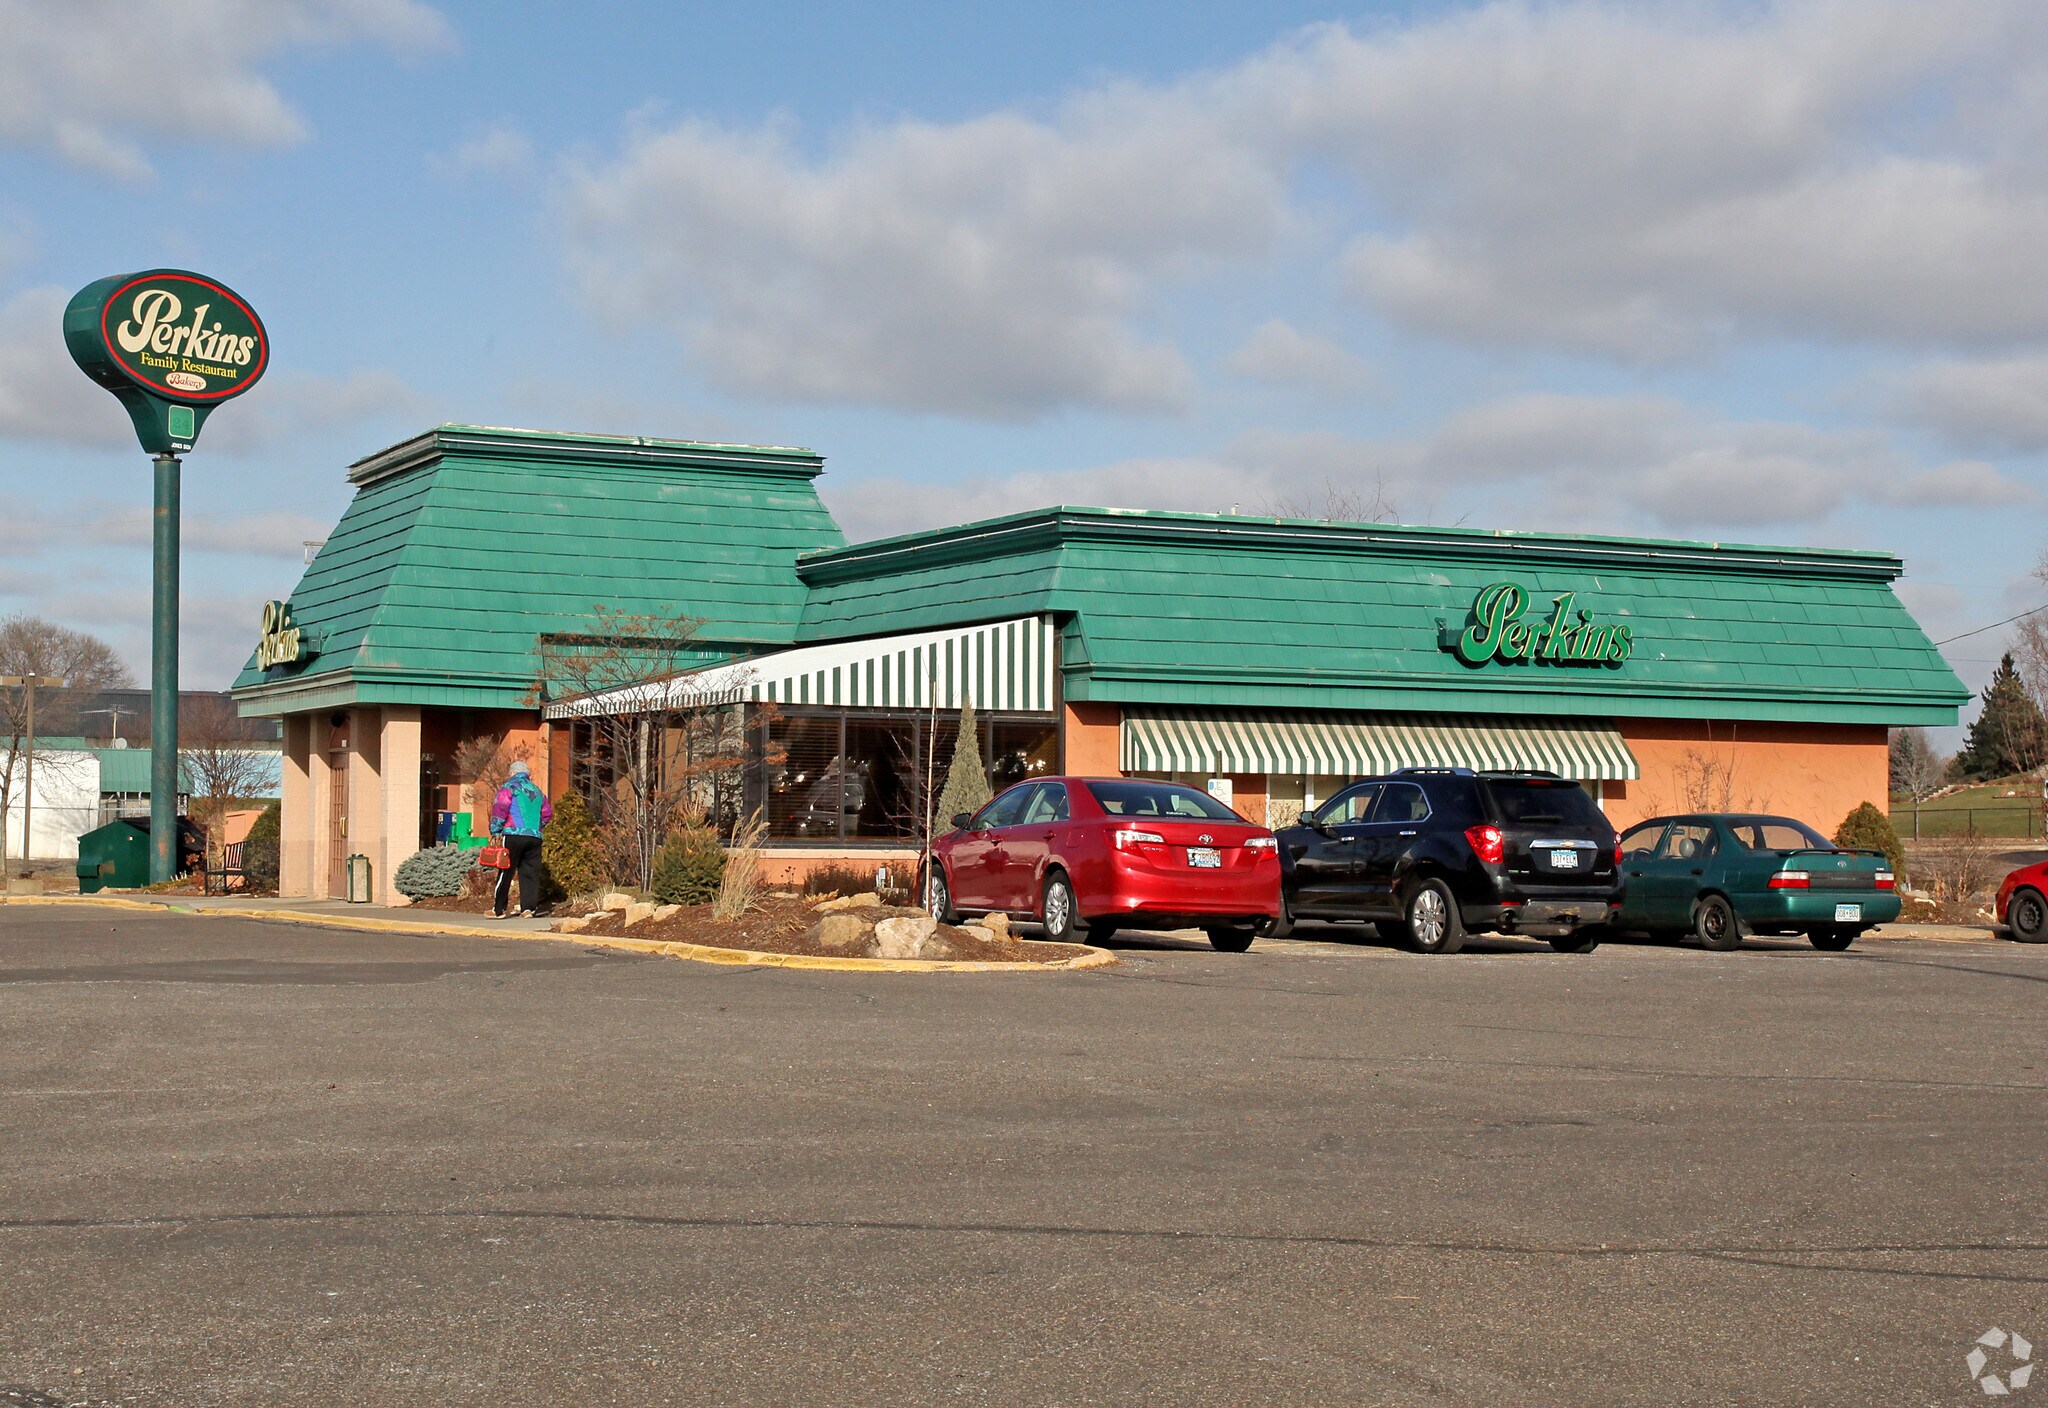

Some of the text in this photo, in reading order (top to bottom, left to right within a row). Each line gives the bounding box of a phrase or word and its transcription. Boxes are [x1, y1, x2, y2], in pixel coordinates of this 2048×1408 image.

[117, 289, 254, 366] Perkins
[140, 351, 238, 379] Family Restaurant
[169, 373, 204, 390] Bakery
[1460, 582, 1633, 662] Perkins
